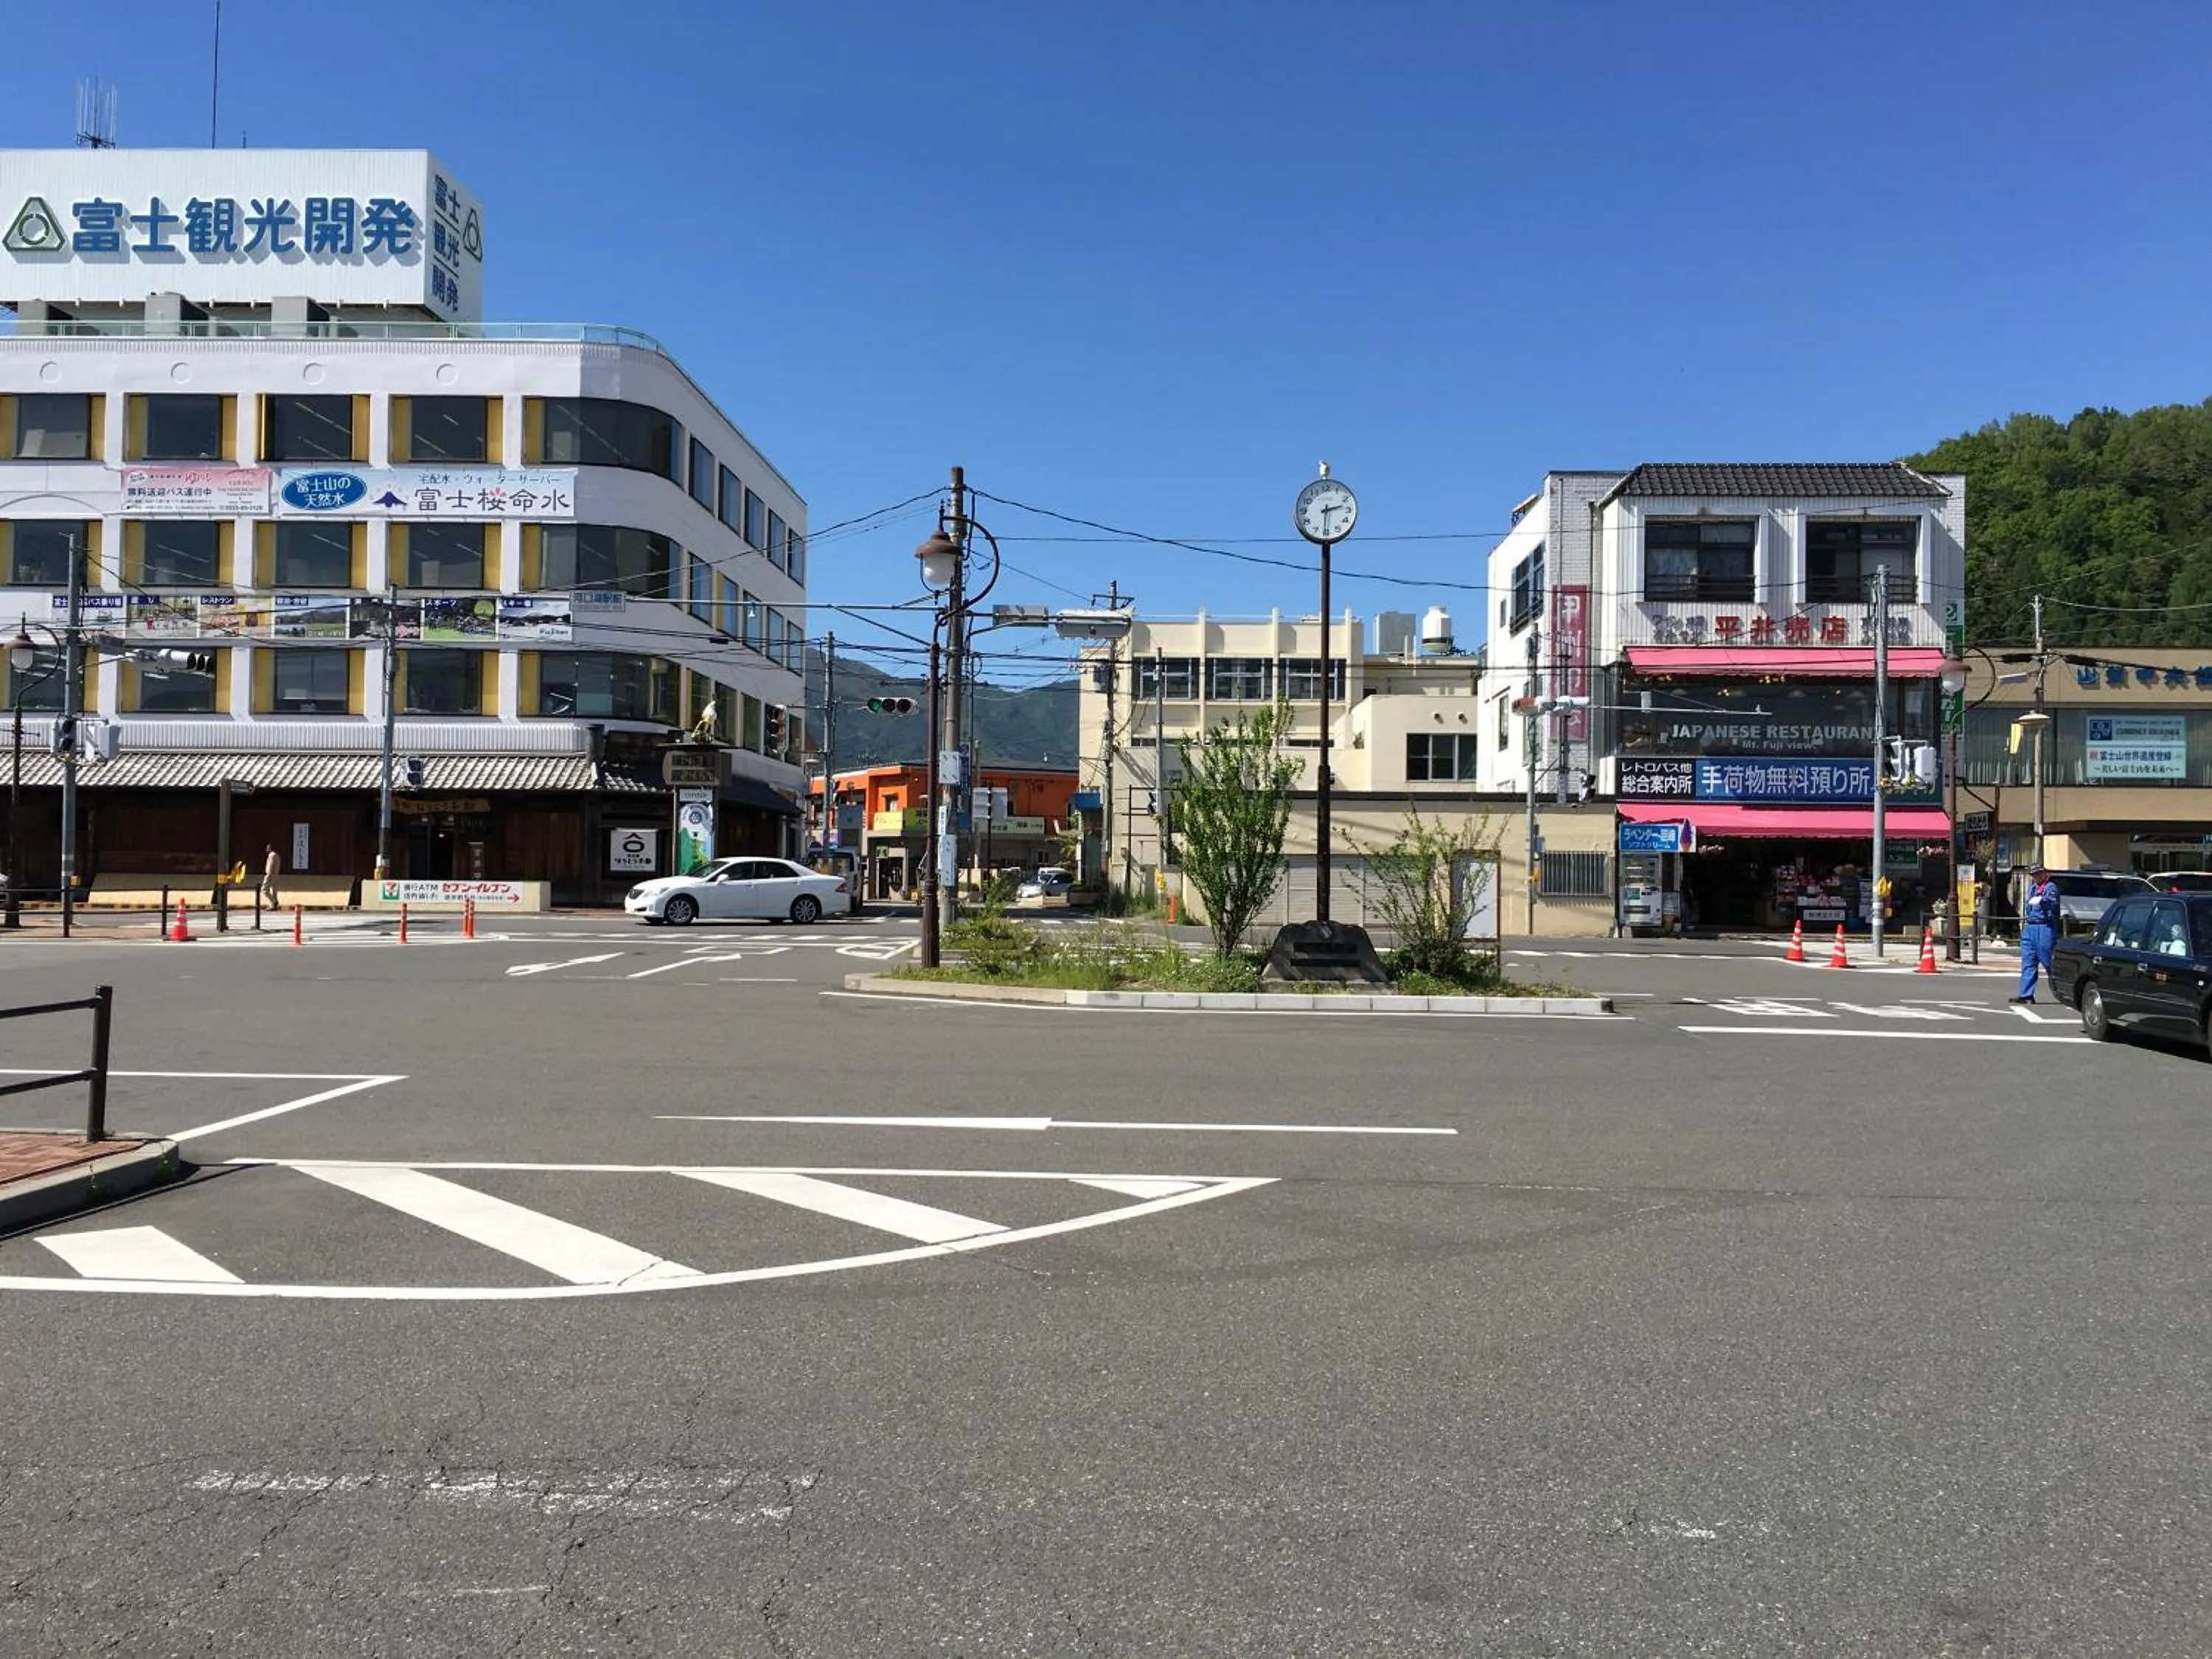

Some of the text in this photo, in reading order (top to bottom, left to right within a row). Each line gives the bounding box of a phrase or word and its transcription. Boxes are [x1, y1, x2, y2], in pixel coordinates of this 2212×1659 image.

[434, 173, 461, 223] 富士
[72, 197, 415, 254] 富士観光開発
[296, 477, 351, 494] 富士山の
[305, 492, 345, 507] 天然水
[414, 487, 570, 512] 富士桜命水
[1672, 725, 1877, 740] JAPANESE RESTAURAN
[1621, 762, 1692, 773] レトロバス他
[1621, 775, 1692, 794] 総合案内所
[1701, 765, 1869, 795] 手荷物無料預り所
